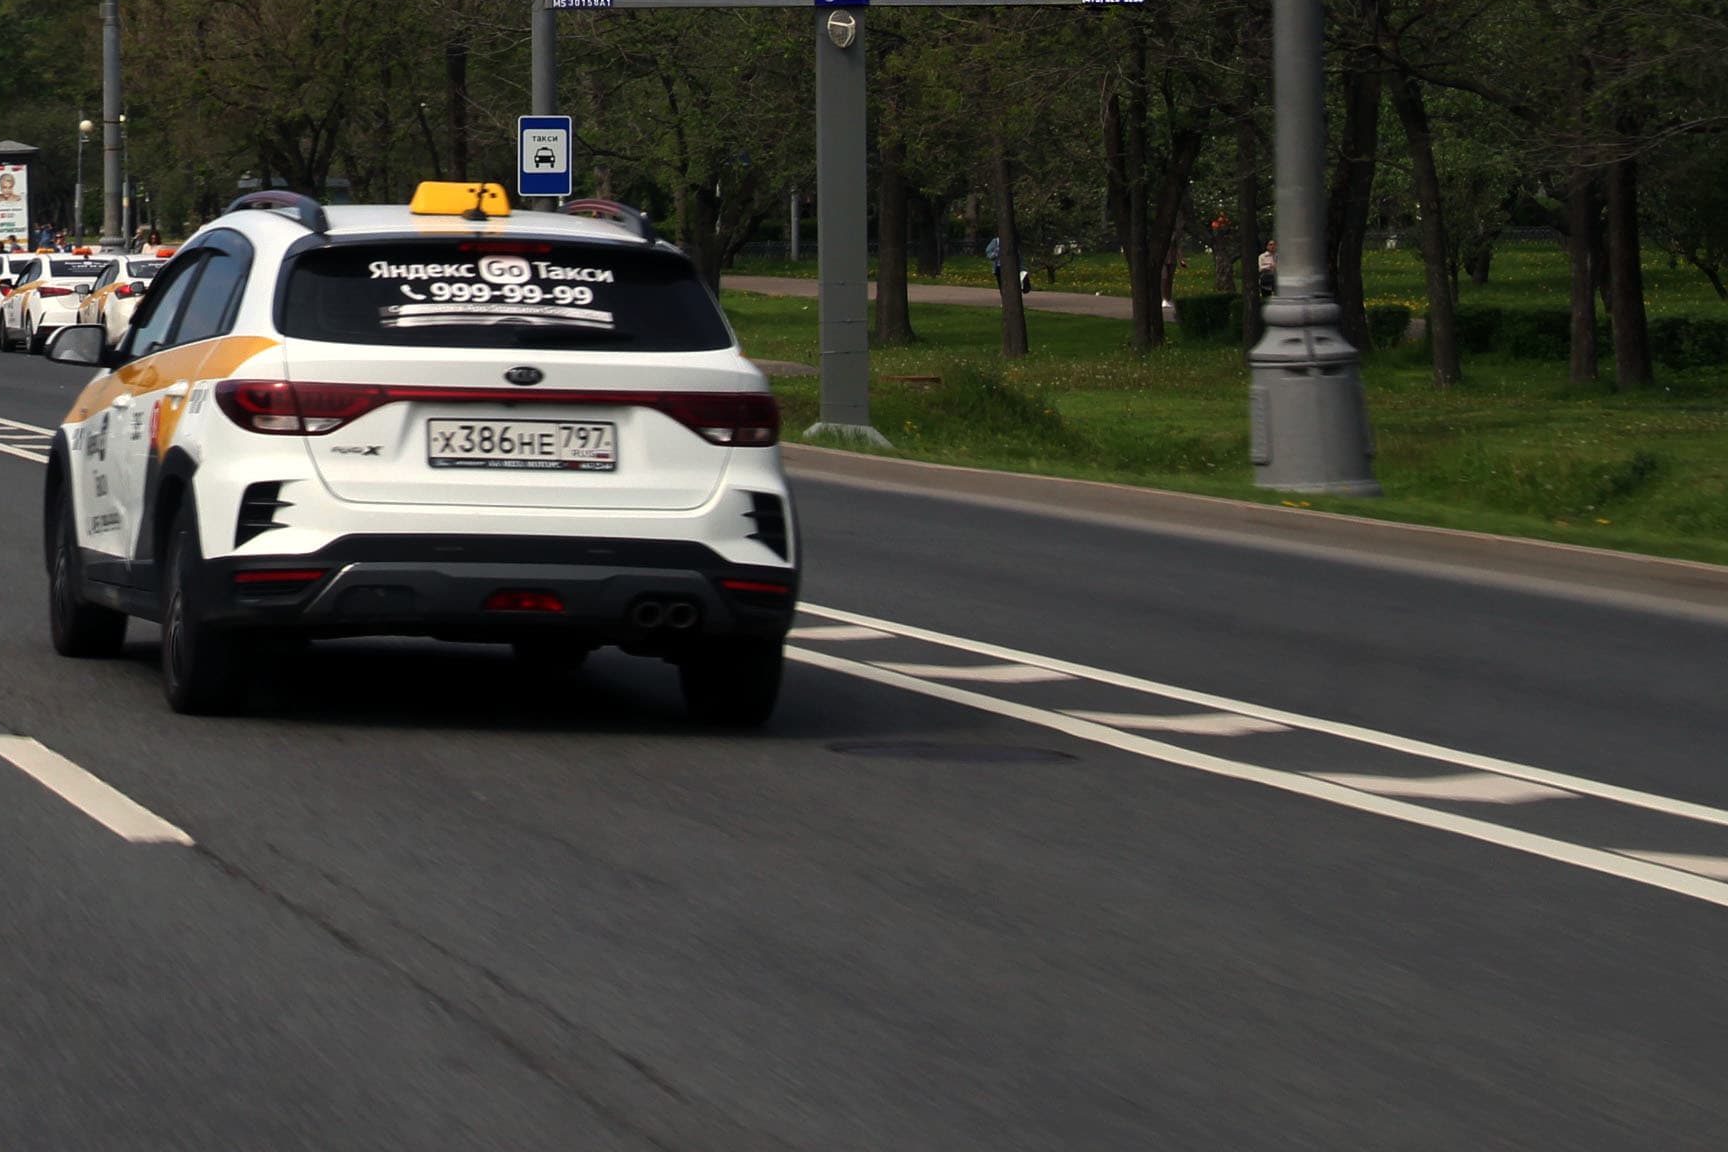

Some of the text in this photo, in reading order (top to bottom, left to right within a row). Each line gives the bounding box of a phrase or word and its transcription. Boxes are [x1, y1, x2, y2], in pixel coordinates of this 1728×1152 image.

[369, 260, 614, 284] Яндекс Go Такси
[430, 282, 593, 305] 999-99-99
[439, 425, 604, 455] Х386НЕ 797
